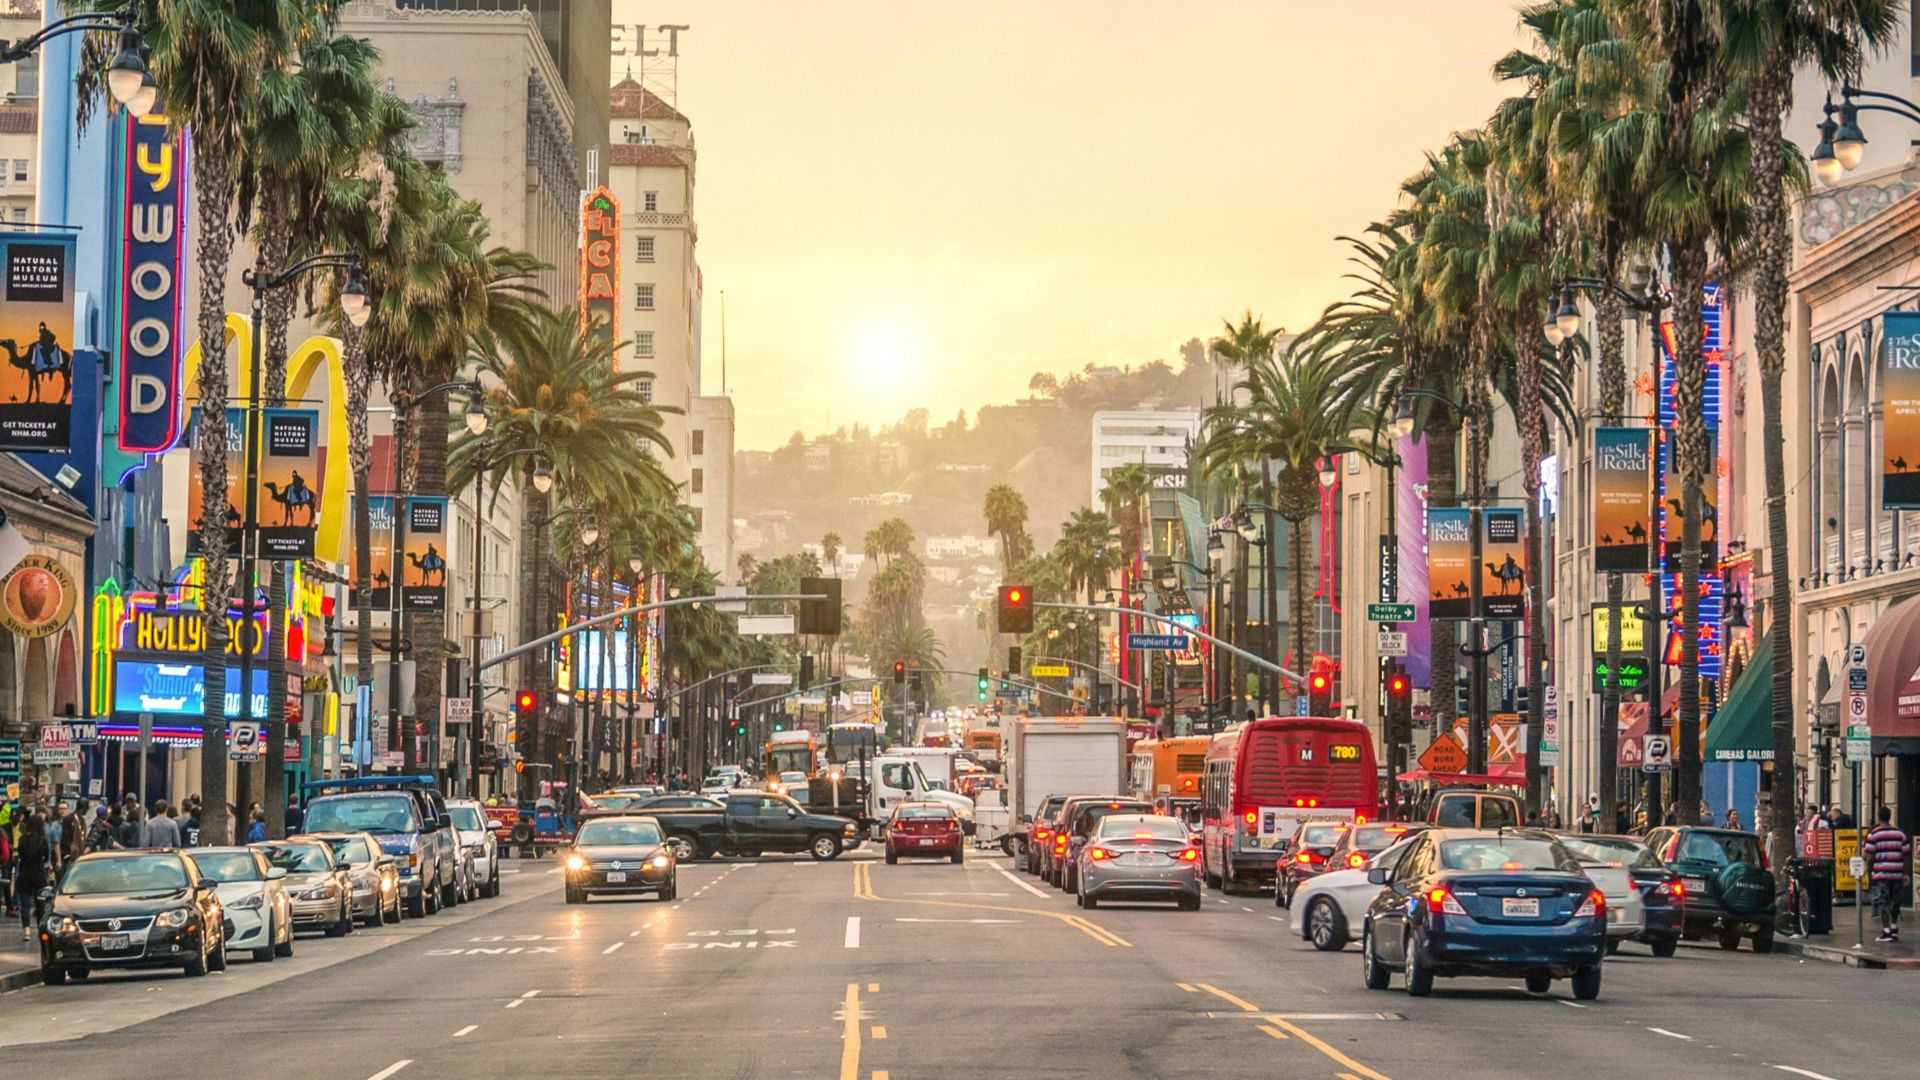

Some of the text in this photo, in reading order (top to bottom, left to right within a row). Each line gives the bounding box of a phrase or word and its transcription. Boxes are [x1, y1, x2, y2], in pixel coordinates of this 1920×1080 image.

[13, 257, 58, 265] NATURAL
[1896, 336, 1910, 346] The
[18, 421, 46, 429] TICKETS
[1615, 443, 1642, 459] Silk
[1604, 453, 1647, 470] Road
[1444, 519, 1468, 533] Silk
[1435, 527, 1468, 541] Road
[1374, 605, 1397, 613] Dolby
[5, 617, 59, 636] Since 1989
[1133, 637, 1169, 647] Highland
[1391, 633, 1402, 641] NOT
[1382, 641, 1401, 649] BLOCK
[43, 727, 69, 740] ATM
[35, 749, 76, 757] INTERNET
[1301, 749, 1313, 760] M
[1333, 746, 1357, 758] 780
[1715, 749, 1775, 759] CAMERAS GALOR
[190, 832, 198, 845] 5
